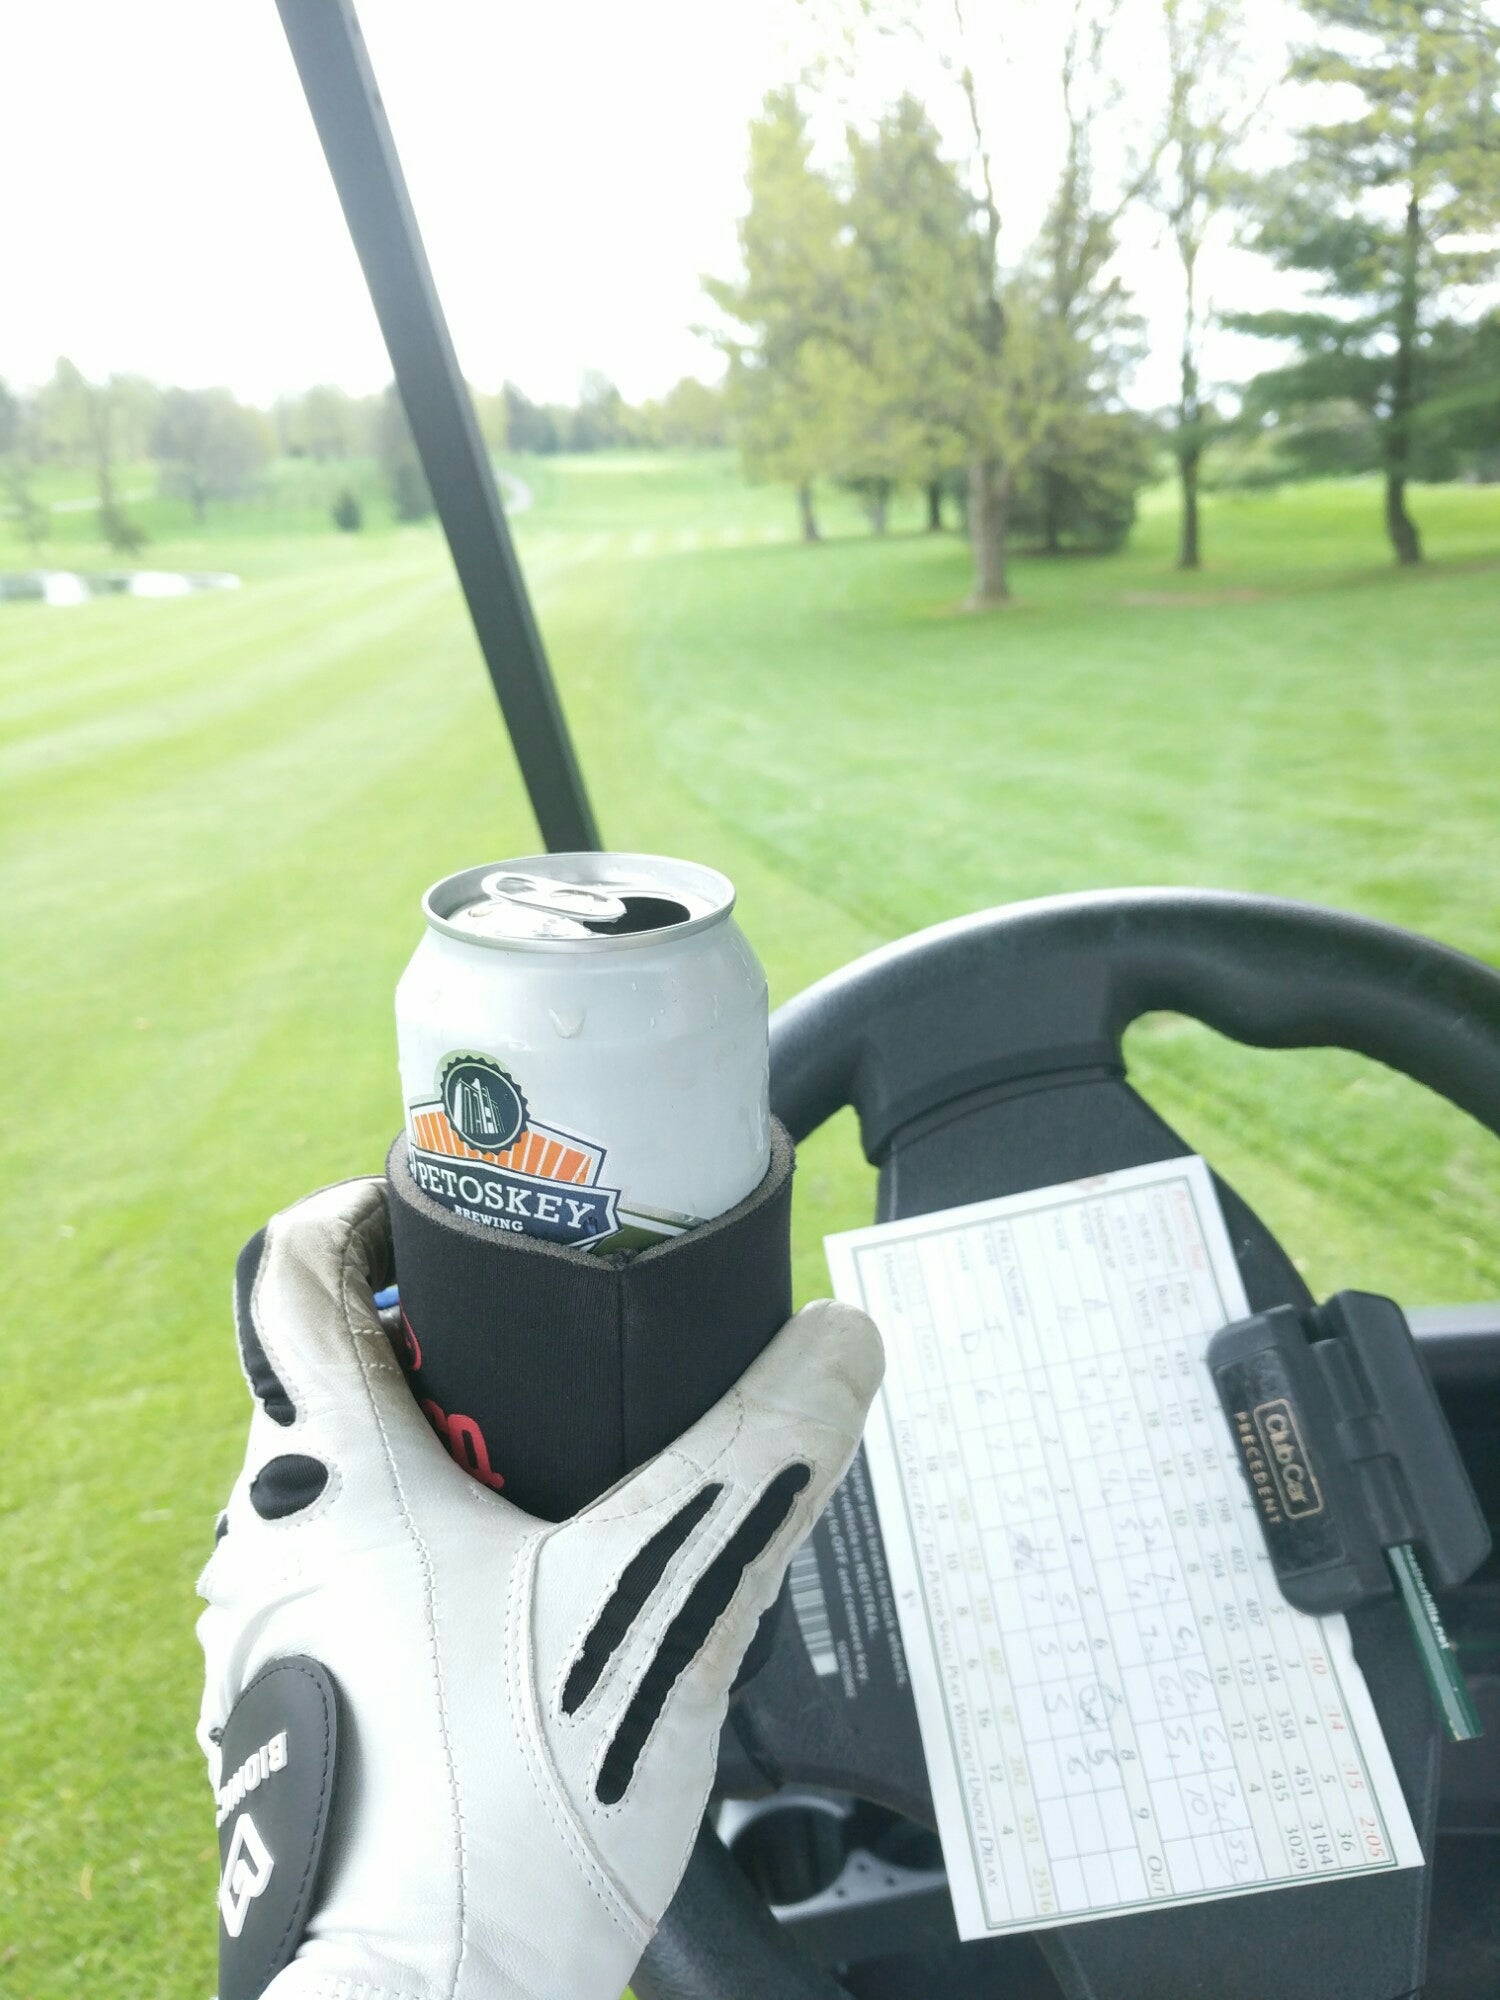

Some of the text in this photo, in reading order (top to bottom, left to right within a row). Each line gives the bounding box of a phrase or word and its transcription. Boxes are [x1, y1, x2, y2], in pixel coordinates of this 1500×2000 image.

[418, 1164, 596, 1229] PETOSKEY
[454, 1203, 524, 1233] BREWING
[1234, 1411, 1283, 1525] PRECEDENT
[1214, 1665, 1231, 1686] 16
[1229, 1720, 1247, 1740] 12
[215, 1731, 288, 1829] BIONIC
[977, 1708, 992, 1728] 16
[987, 1764, 1003, 1783] 12
[1236, 1658, 1256, 1687] 122
[1252, 1712, 1272, 1743] 342
[1268, 1768, 1289, 1802] 435
[1283, 1825, 1309, 1870] 3029
[1260, 1653, 1280, 1682] 144
[1276, 1708, 1297, 1739] 358
[1293, 1764, 1314, 1796] 451
[1309, 1820, 1334, 1865] 3184
[1302, 1714, 1317, 1726] 4
[1319, 1771, 1336, 1785] 5
[1336, 1827, 1357, 1852] 36
[1134, 1805, 1151, 1821] 9
[1358, 1814, 1385, 1858] 2:05
[1032, 1866, 1056, 1912] 2516
